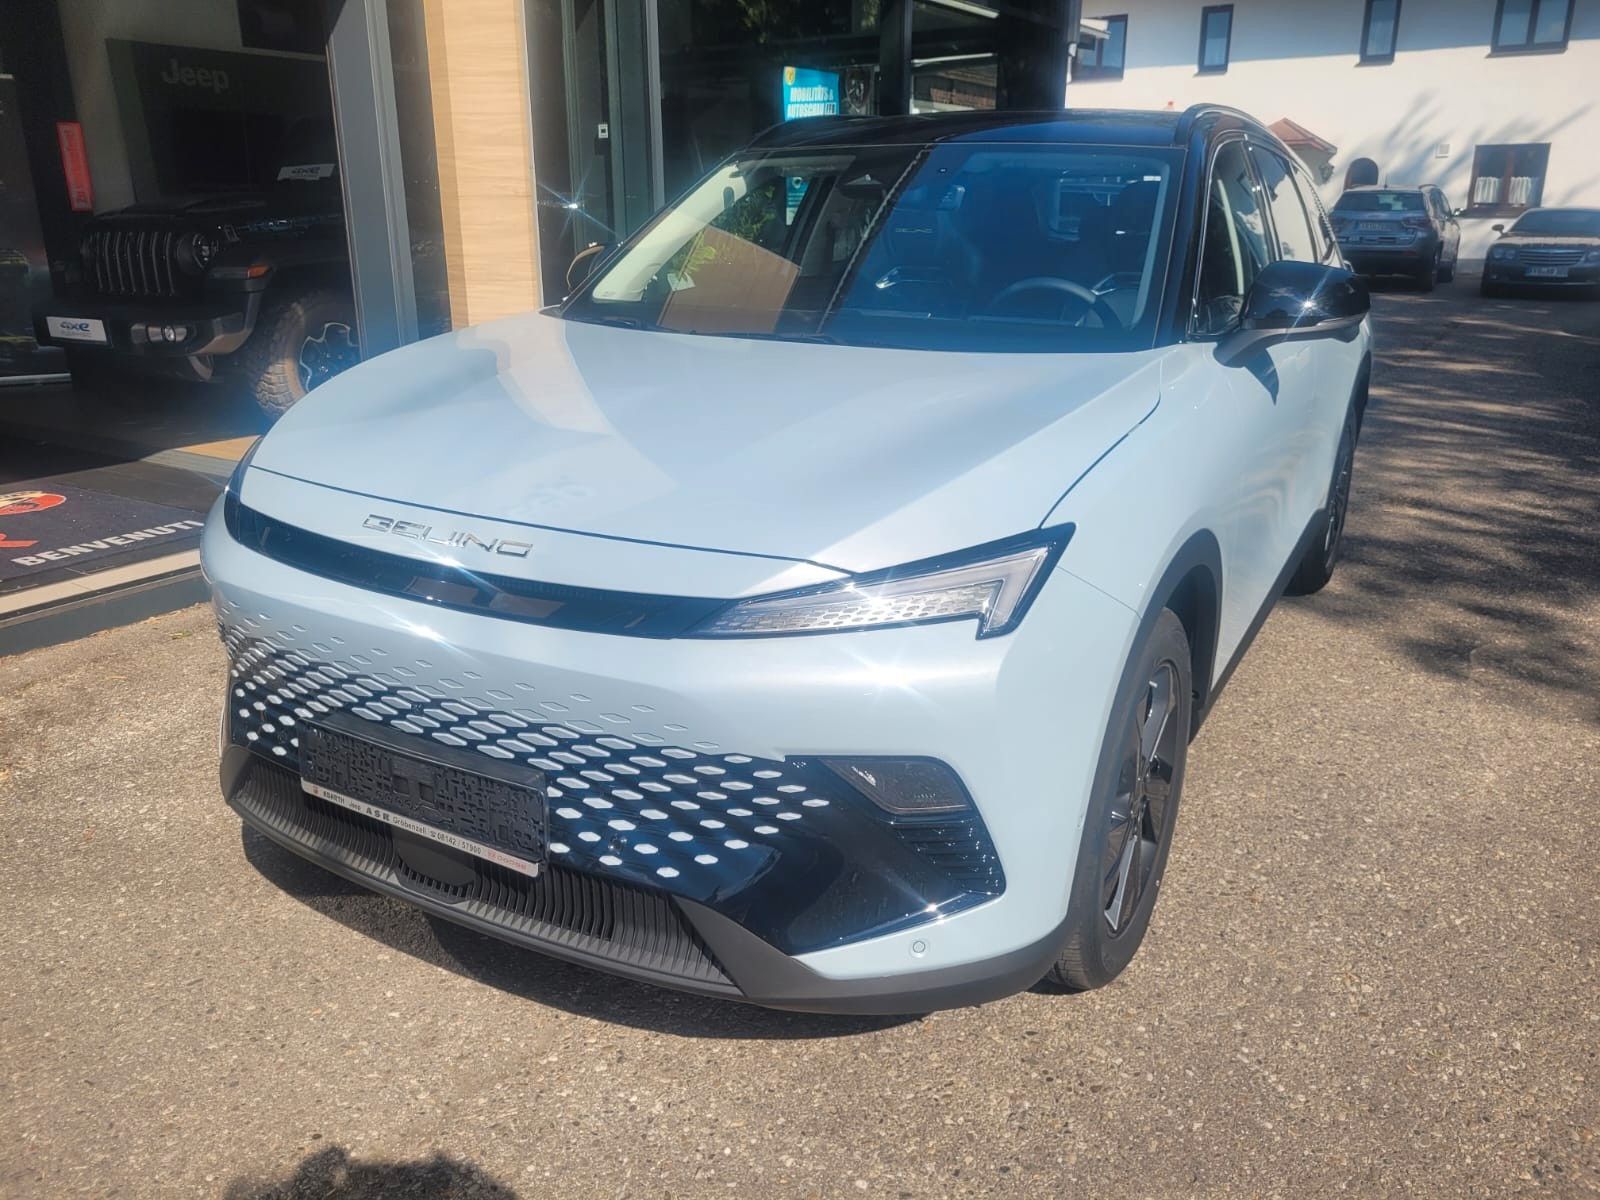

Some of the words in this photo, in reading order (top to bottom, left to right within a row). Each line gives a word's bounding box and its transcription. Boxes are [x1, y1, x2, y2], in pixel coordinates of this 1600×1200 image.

[160, 56, 229, 94] Jeep
[11, 520, 204, 566] BENVENUTI
[362, 514, 533, 558] BEIJING
[323, 791, 345, 805] ABARTH
